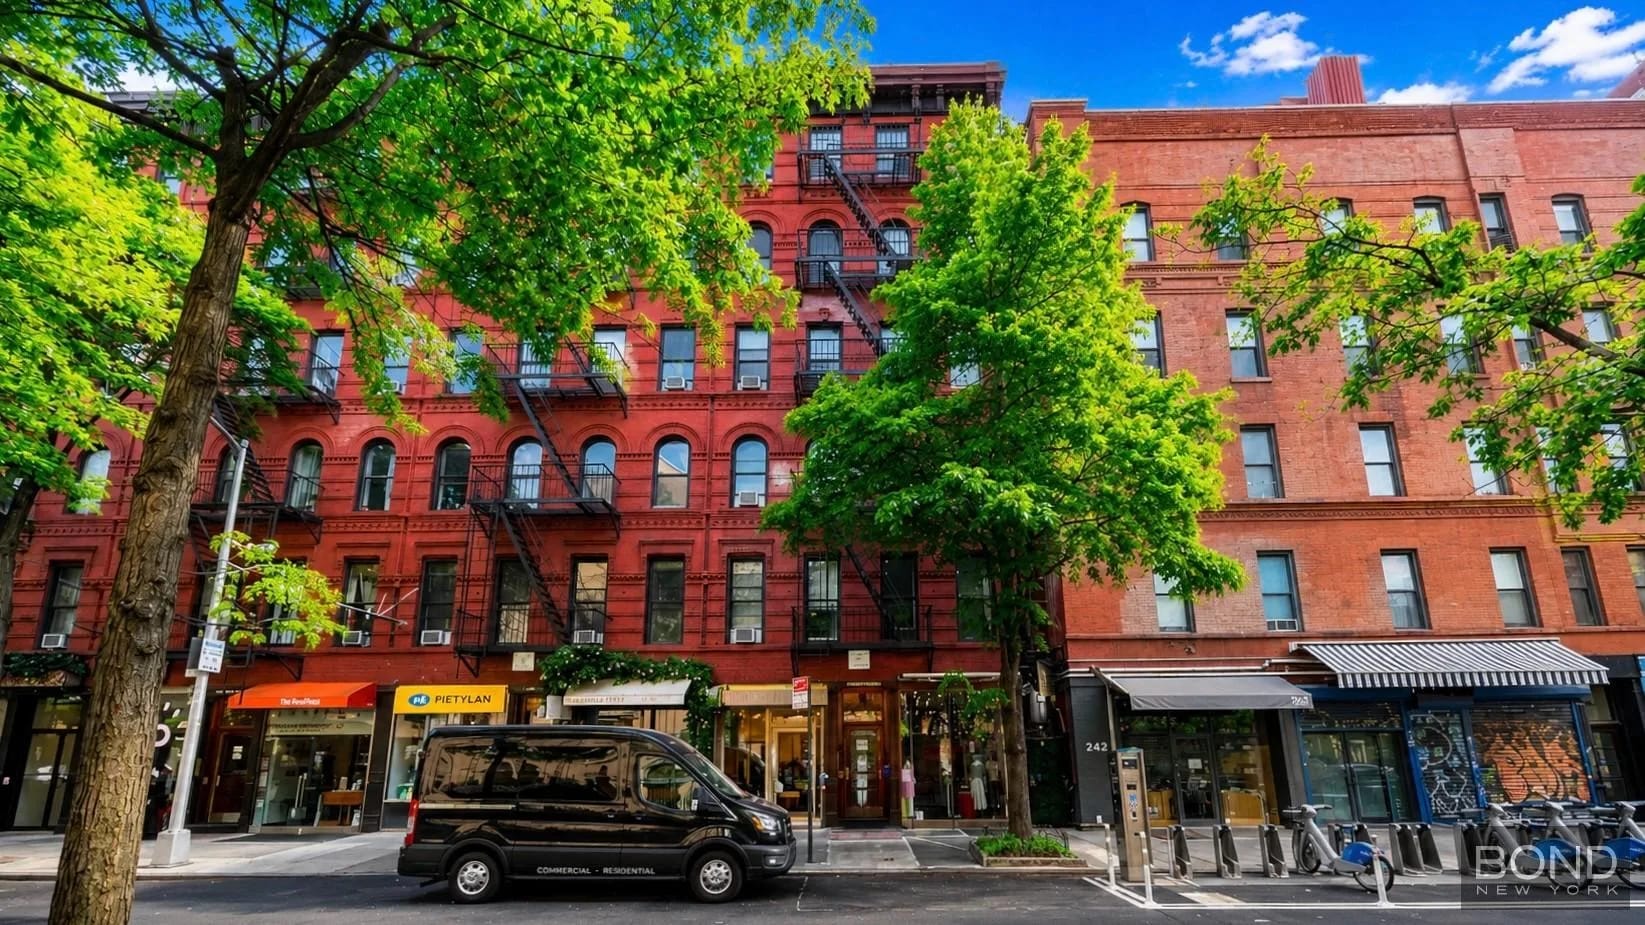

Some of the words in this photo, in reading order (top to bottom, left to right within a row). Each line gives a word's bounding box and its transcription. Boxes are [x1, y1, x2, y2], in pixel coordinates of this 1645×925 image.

[435, 695, 491, 704] PIETYLAN
[1085, 742, 1108, 752] 242
[536, 866, 592, 874] COMMERCIAL
